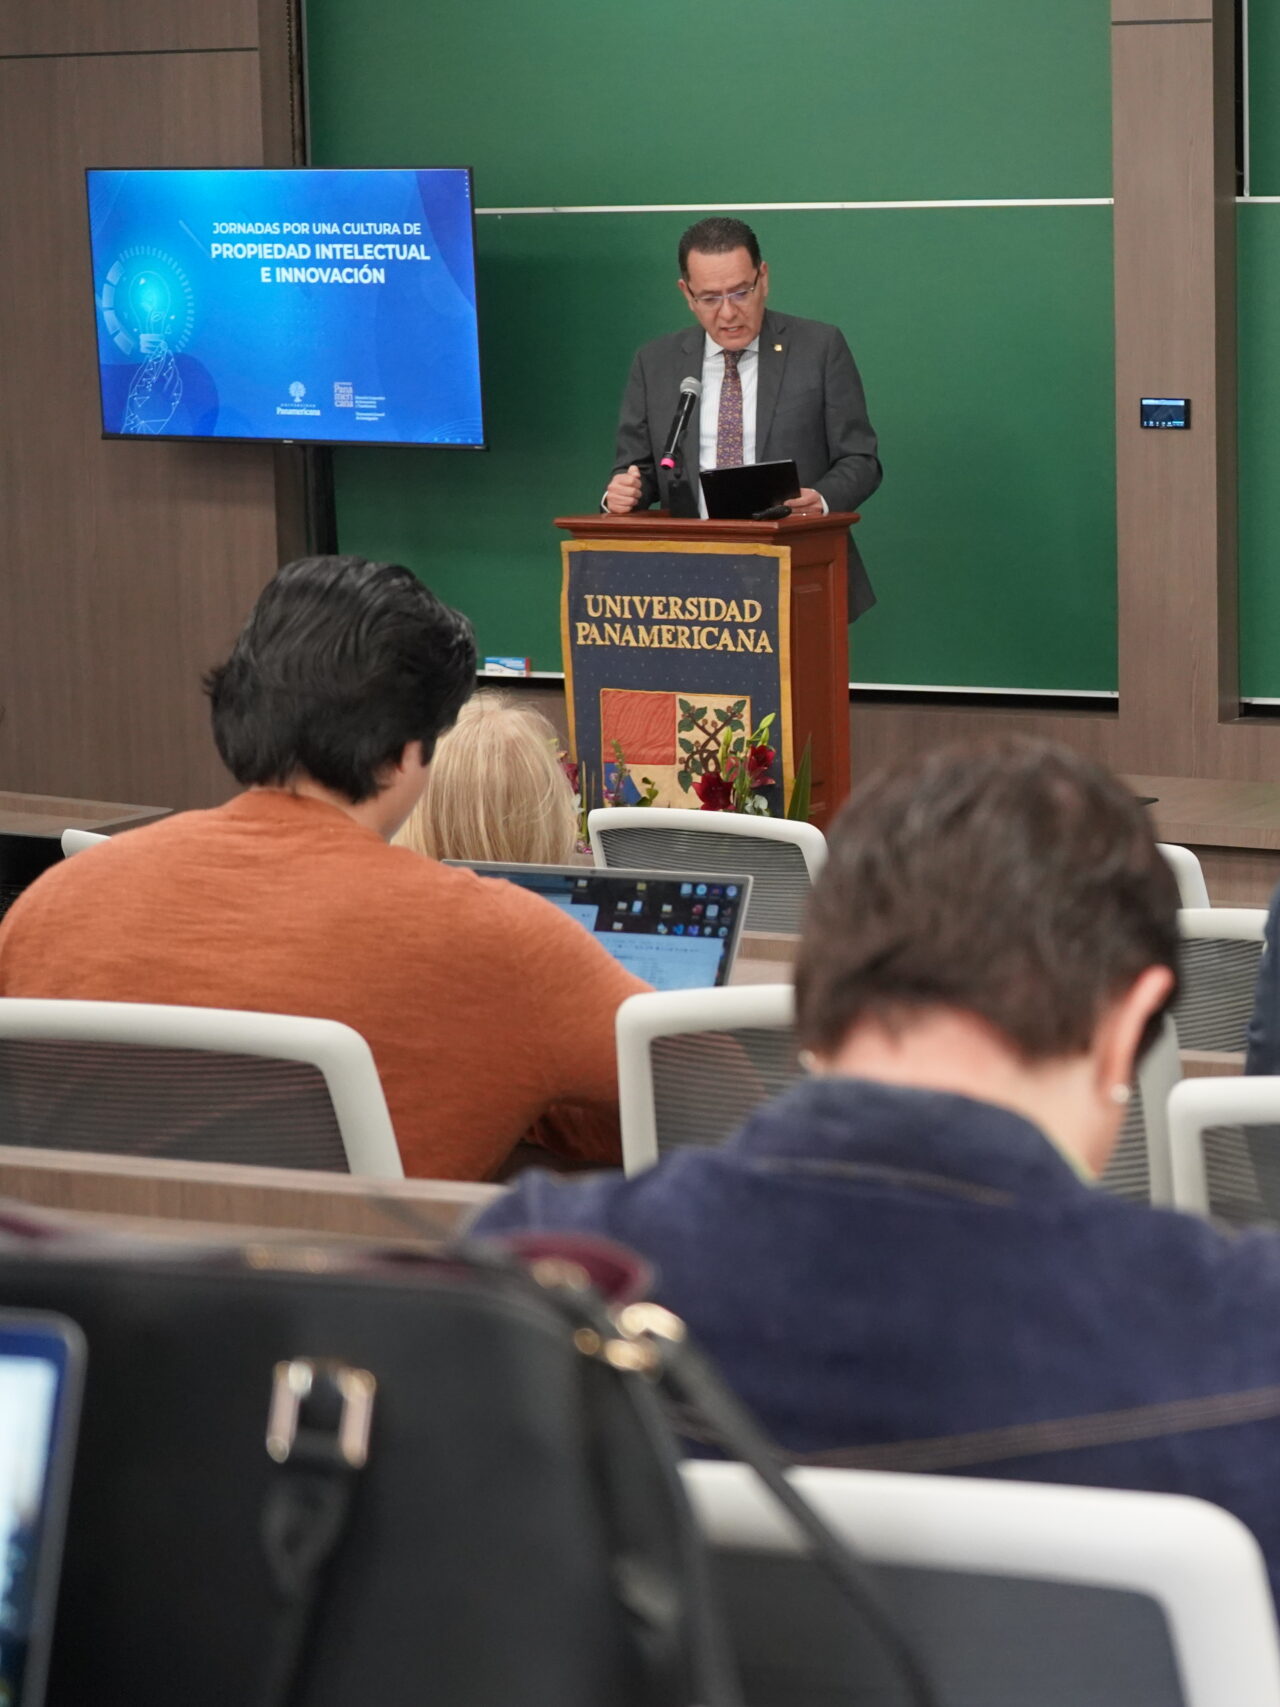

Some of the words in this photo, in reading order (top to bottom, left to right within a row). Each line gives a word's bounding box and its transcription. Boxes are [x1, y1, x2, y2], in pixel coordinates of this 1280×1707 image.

[212, 222, 280, 235] JORNADAS
[283, 222, 310, 235] POR
[312, 222, 341, 235] UNA
[342, 222, 401, 235] CULTURA
[403, 222, 422, 235] DE
[210, 243, 312, 260] PROPIEDAD
[315, 243, 431, 261] INTELECTUAL
[261, 266, 272, 283] E
[275, 263, 386, 284] INNOVACIÓN
[584, 594, 763, 623] UNIVERSIDAD
[575, 622, 774, 654] PANAMERICANA
